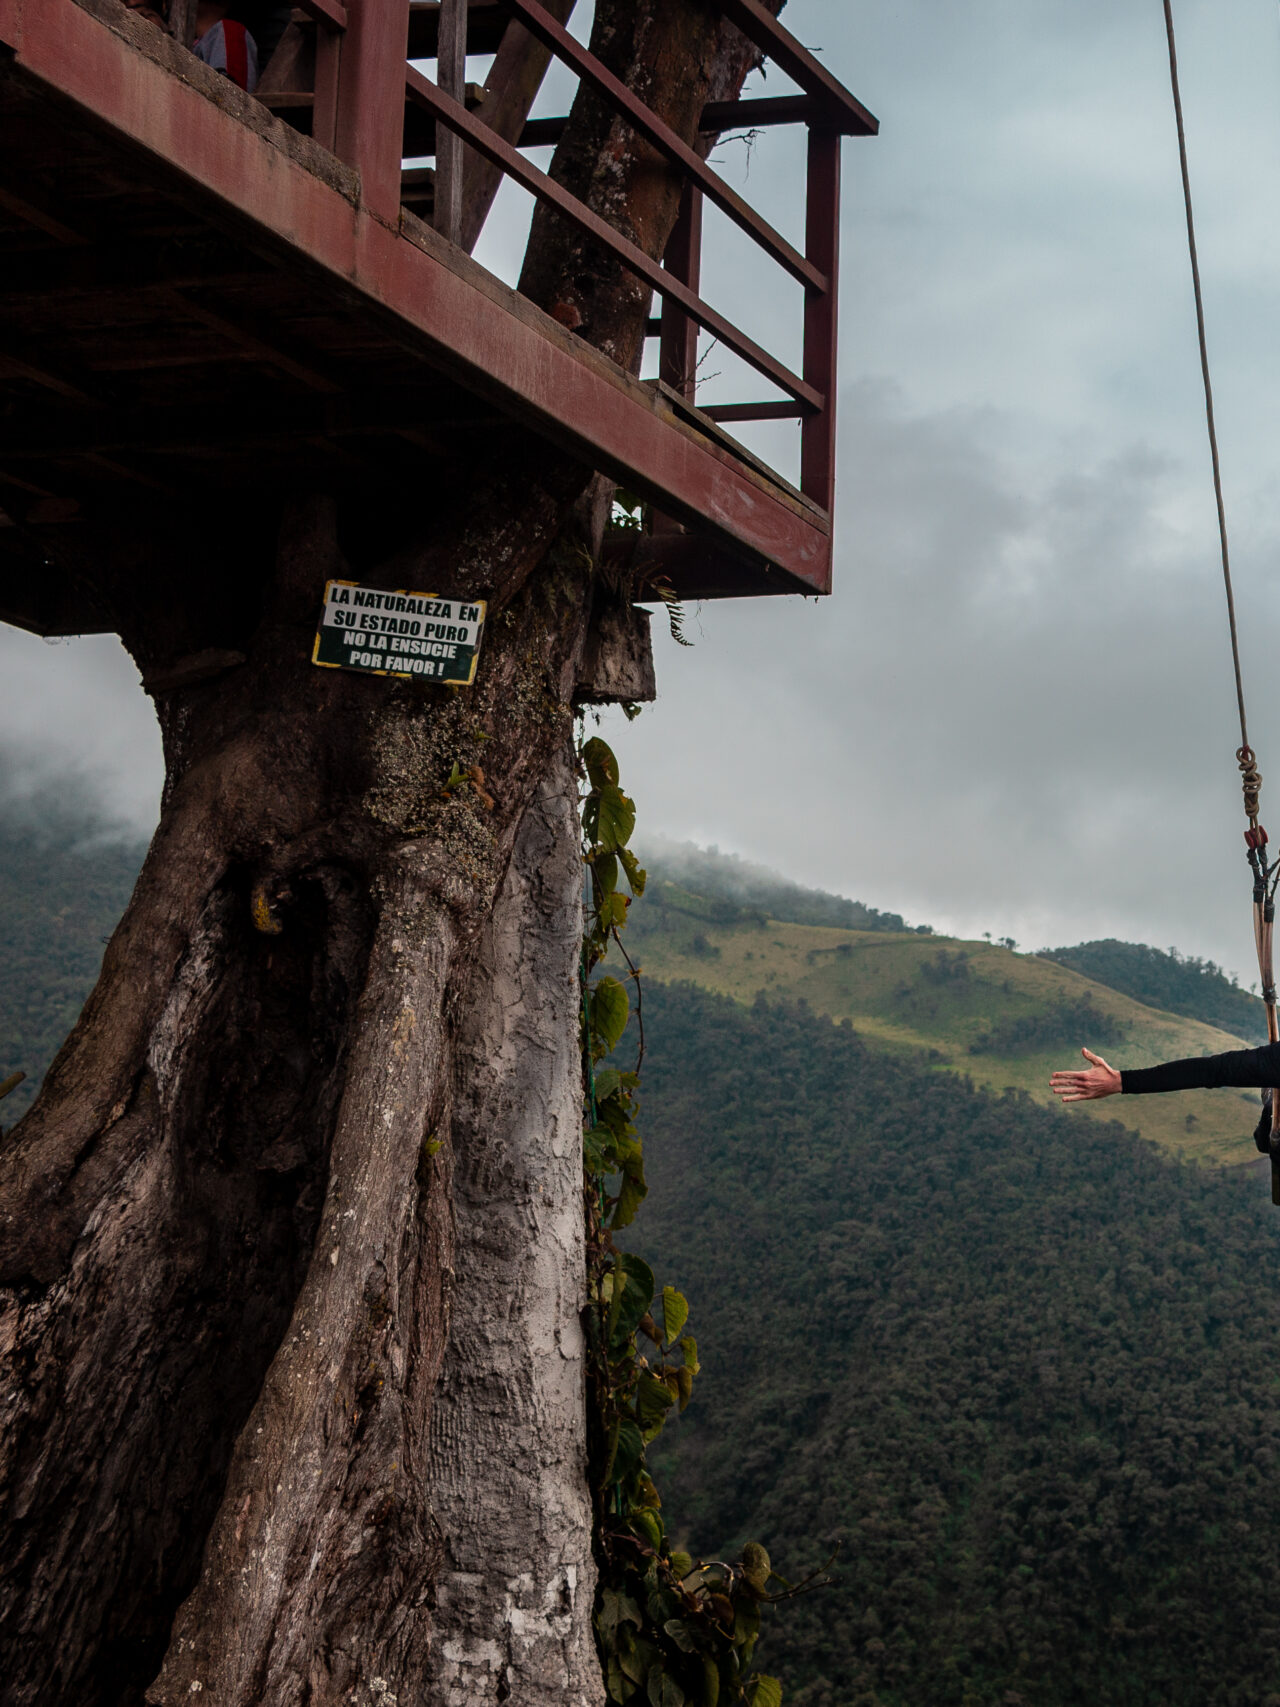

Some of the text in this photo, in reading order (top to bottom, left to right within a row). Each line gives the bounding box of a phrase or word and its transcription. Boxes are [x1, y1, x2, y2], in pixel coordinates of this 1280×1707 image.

[331, 588, 479, 622] LA NATURALEZA EN
[334, 610, 468, 642] SU ESTADO PURO
[343, 631, 457, 658] NO LA ENSUCIE
[350, 651, 382, 668] POR
[385, 655, 434, 675] FAVOR
